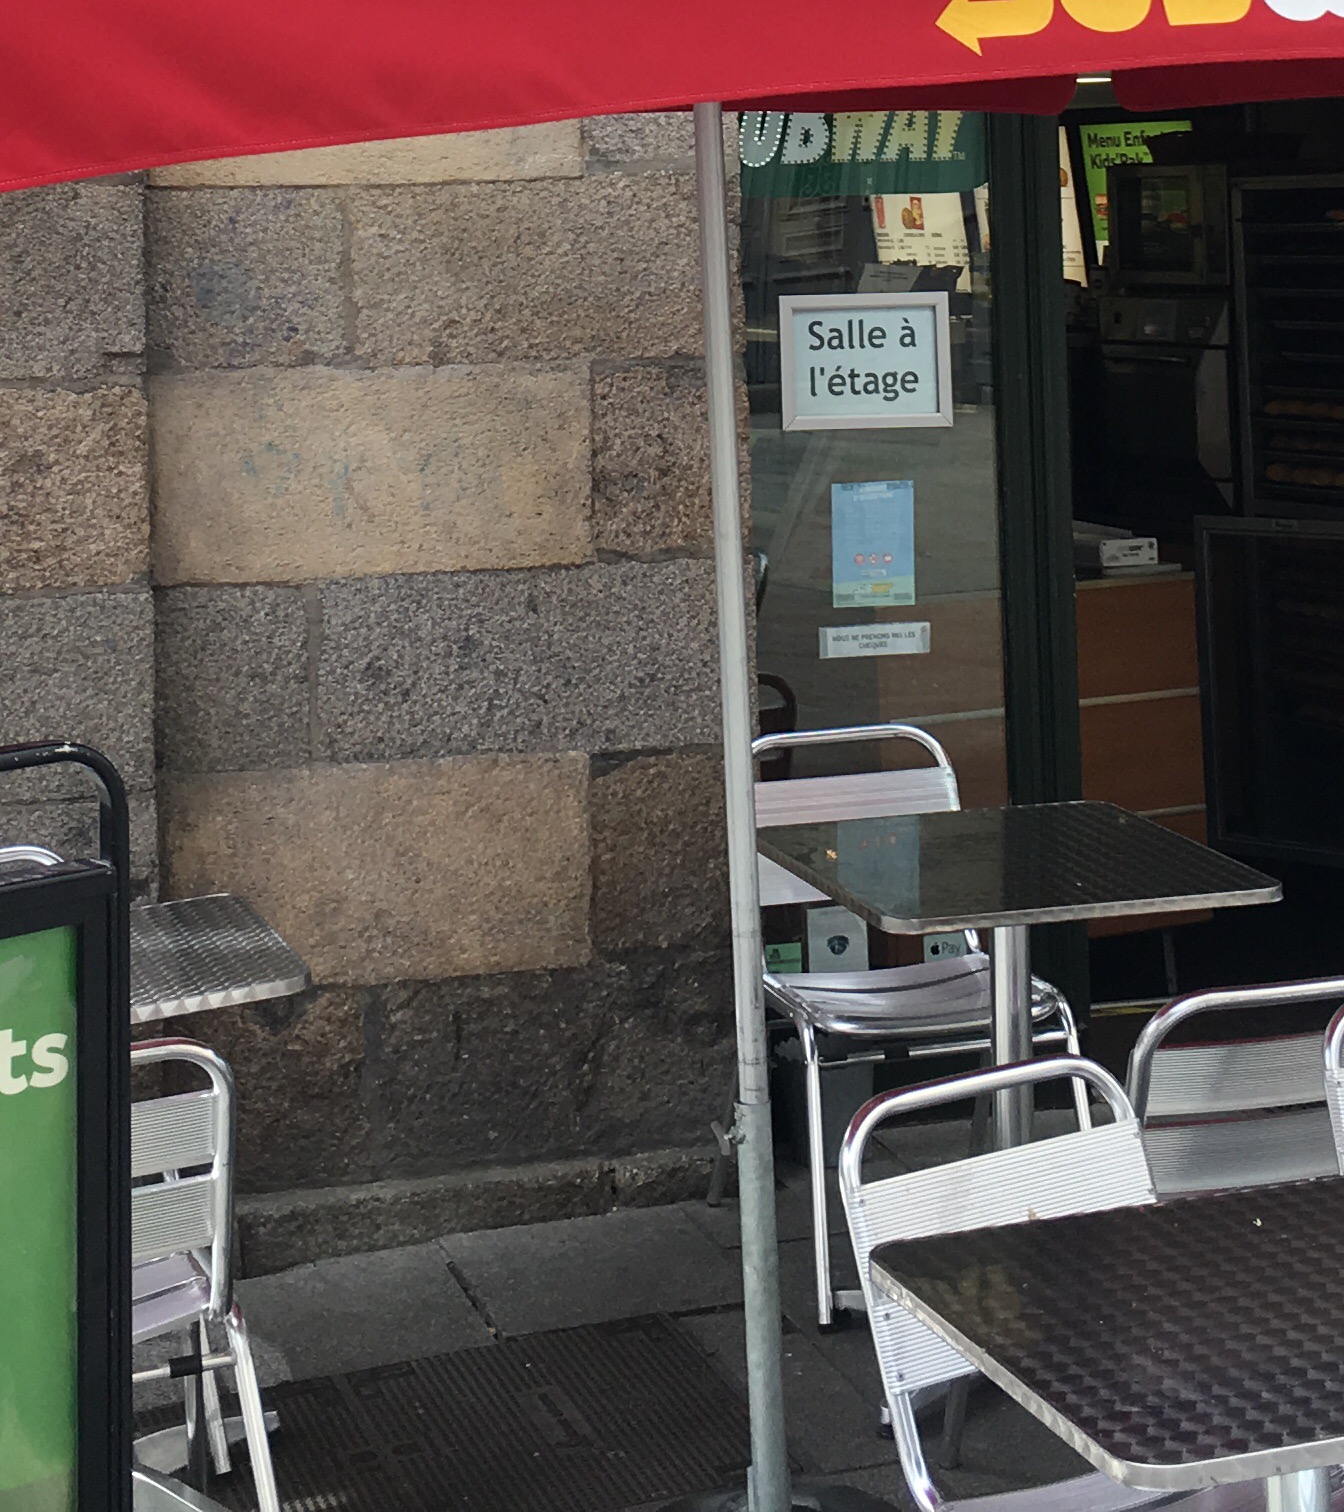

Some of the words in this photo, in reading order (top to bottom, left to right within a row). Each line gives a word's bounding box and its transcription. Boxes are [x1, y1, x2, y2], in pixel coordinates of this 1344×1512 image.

[808, 319, 888, 351] Salle
[899, 317, 918, 349] à
[809, 365, 920, 403] l'étage
